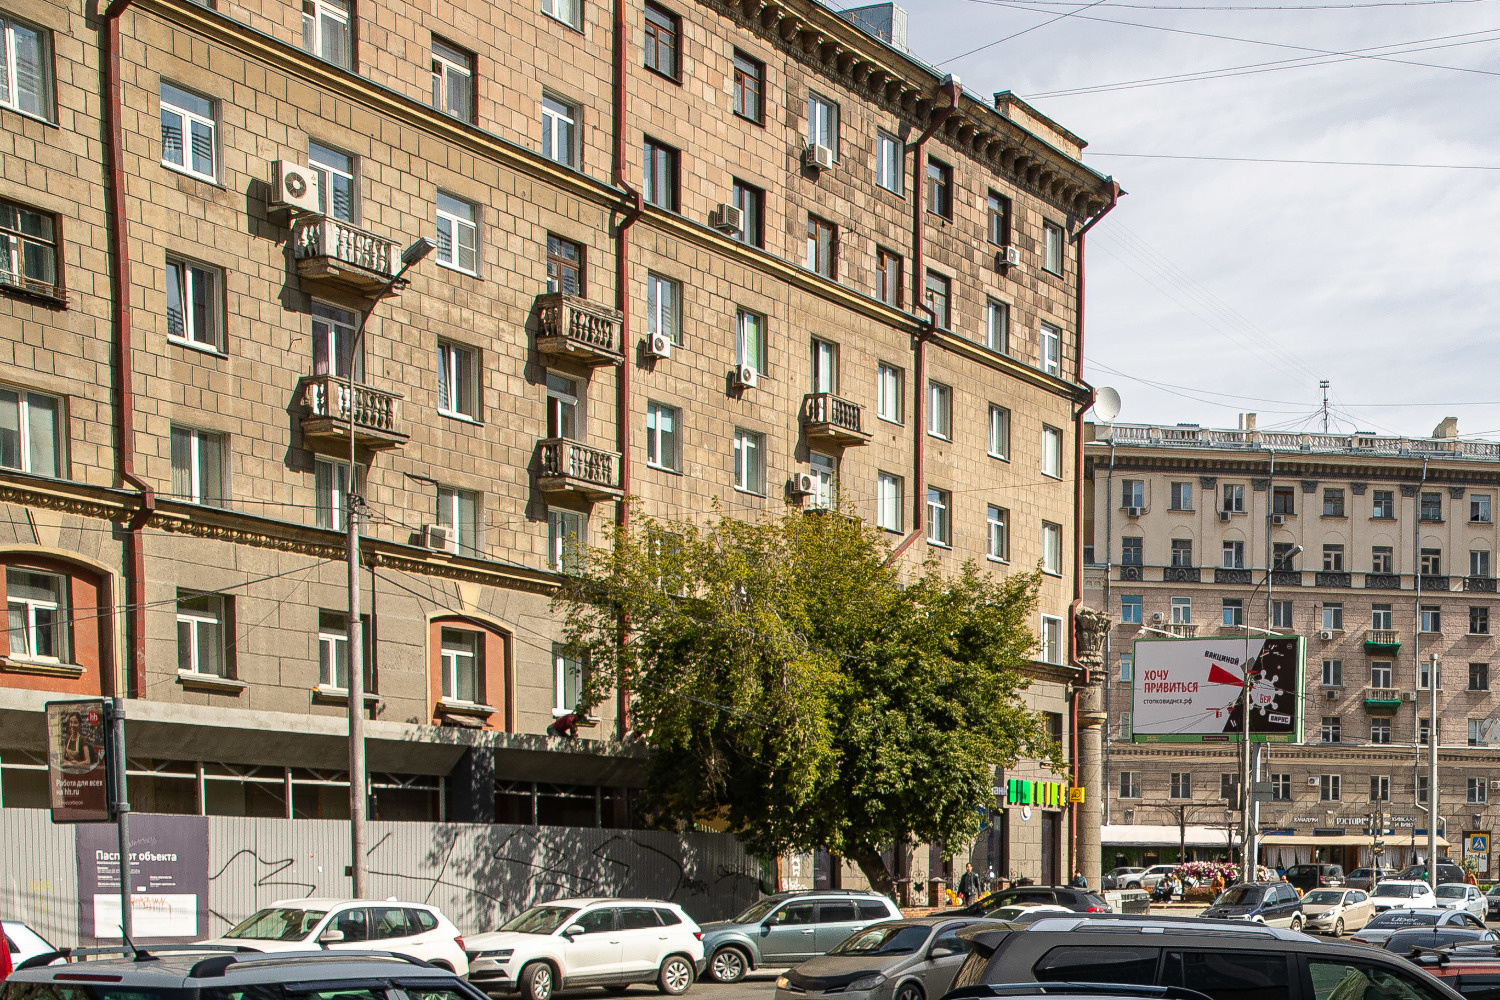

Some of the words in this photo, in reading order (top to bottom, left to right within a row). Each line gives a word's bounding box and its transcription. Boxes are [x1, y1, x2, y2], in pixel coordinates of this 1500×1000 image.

[1204, 650, 1240, 666] ВАКЦИНОЙ
[1144, 669, 1169, 682] ХОЧУ
[1144, 681, 1199, 694] ПРИВИТЬСЯ
[89, 713, 98, 722] hh
[77, 780, 88, 788] для
[64, 788, 80, 796] hh.ru
[138, 851, 177, 862] объекта
